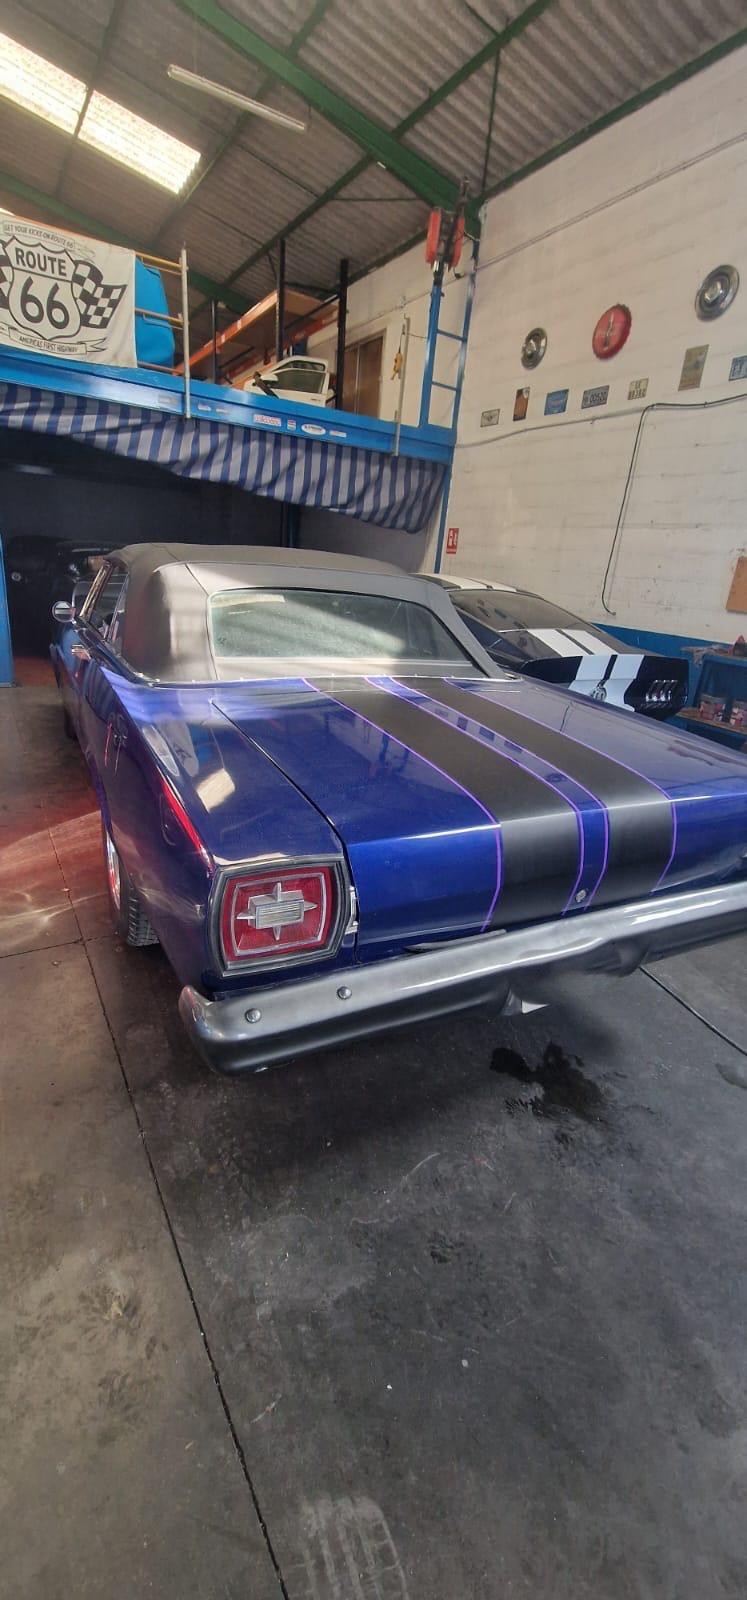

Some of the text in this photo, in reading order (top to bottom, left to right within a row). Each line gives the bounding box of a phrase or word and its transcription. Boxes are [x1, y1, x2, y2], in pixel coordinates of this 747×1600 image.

[14, 225, 27, 233] YOUR
[29, 228, 42, 236] KICKS
[51, 234, 66, 245] ROUTE
[15, 247, 67, 276] ROUTE
[20, 276, 70, 330] 66
[44, 341, 56, 351] FIRST
[57, 344, 77, 353] HIGHWAY
